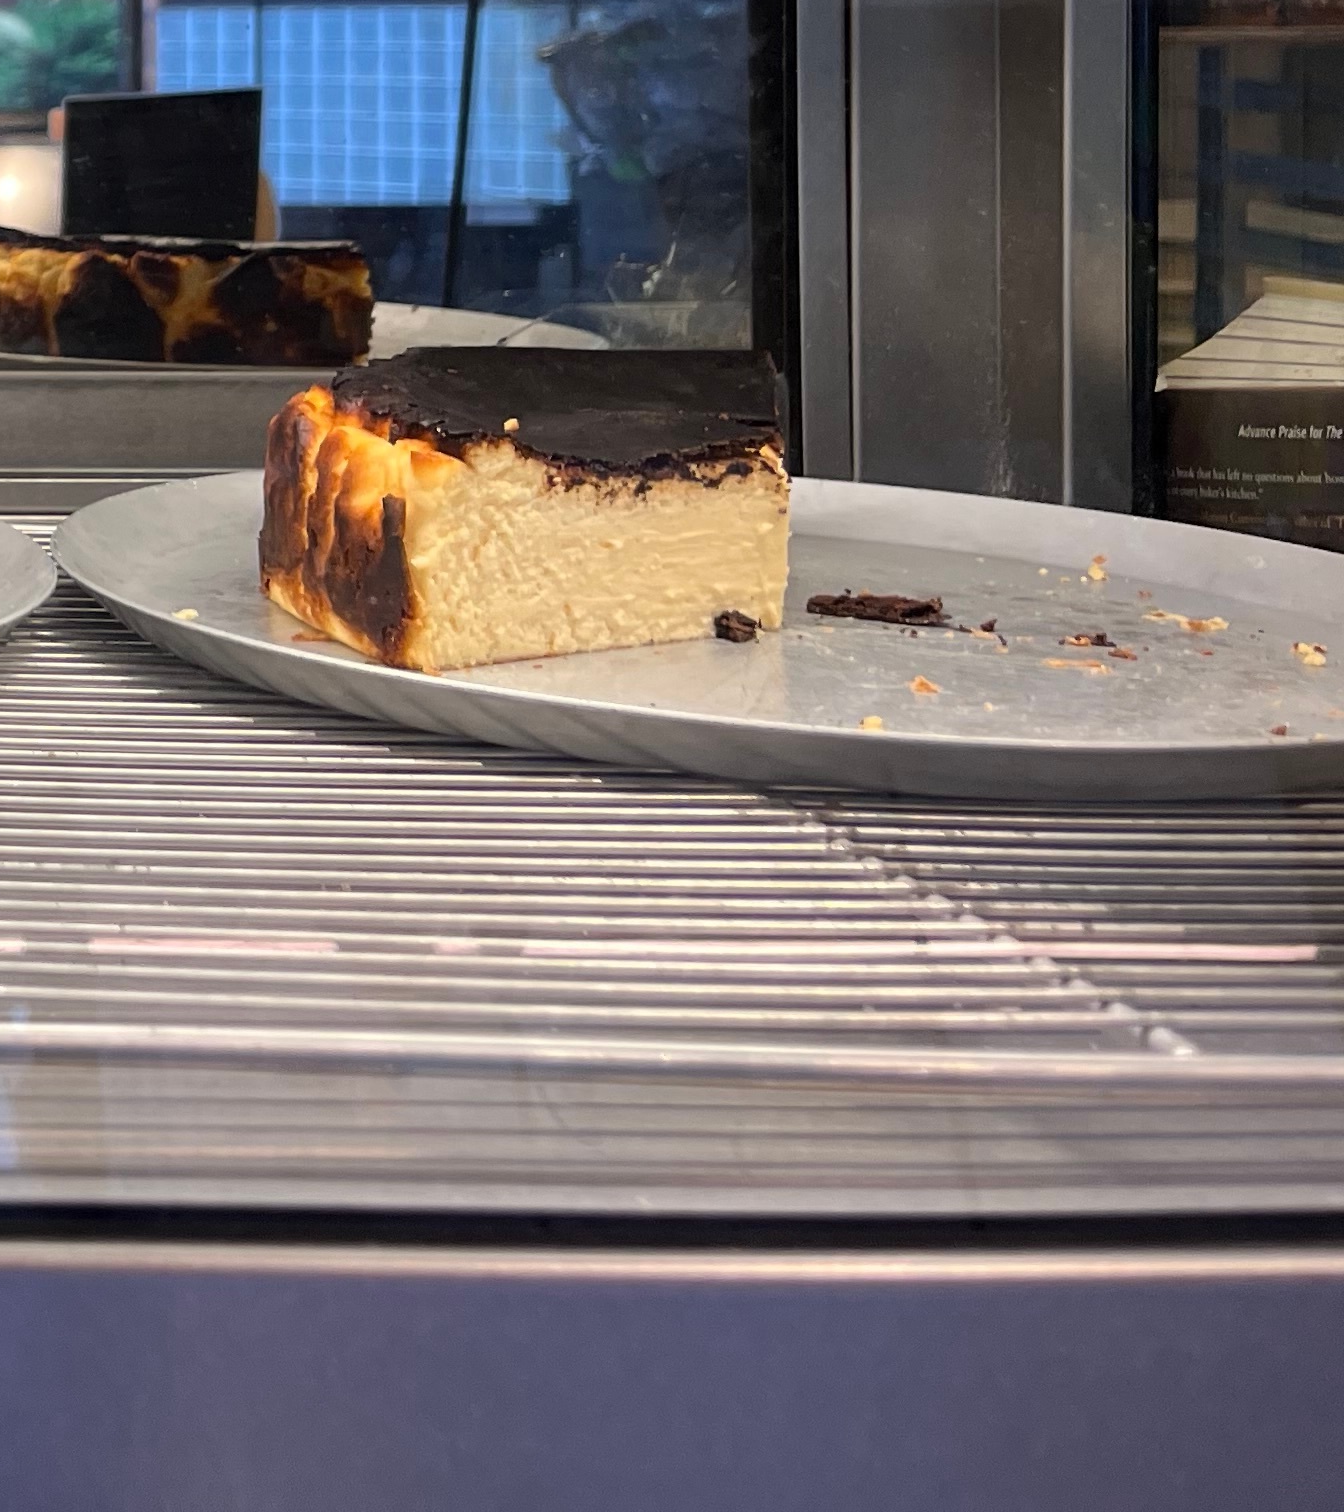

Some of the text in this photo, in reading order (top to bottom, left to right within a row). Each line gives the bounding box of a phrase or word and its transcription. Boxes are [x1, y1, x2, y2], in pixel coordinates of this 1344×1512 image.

[1238, 423, 1344, 440] Advance Praise for The
